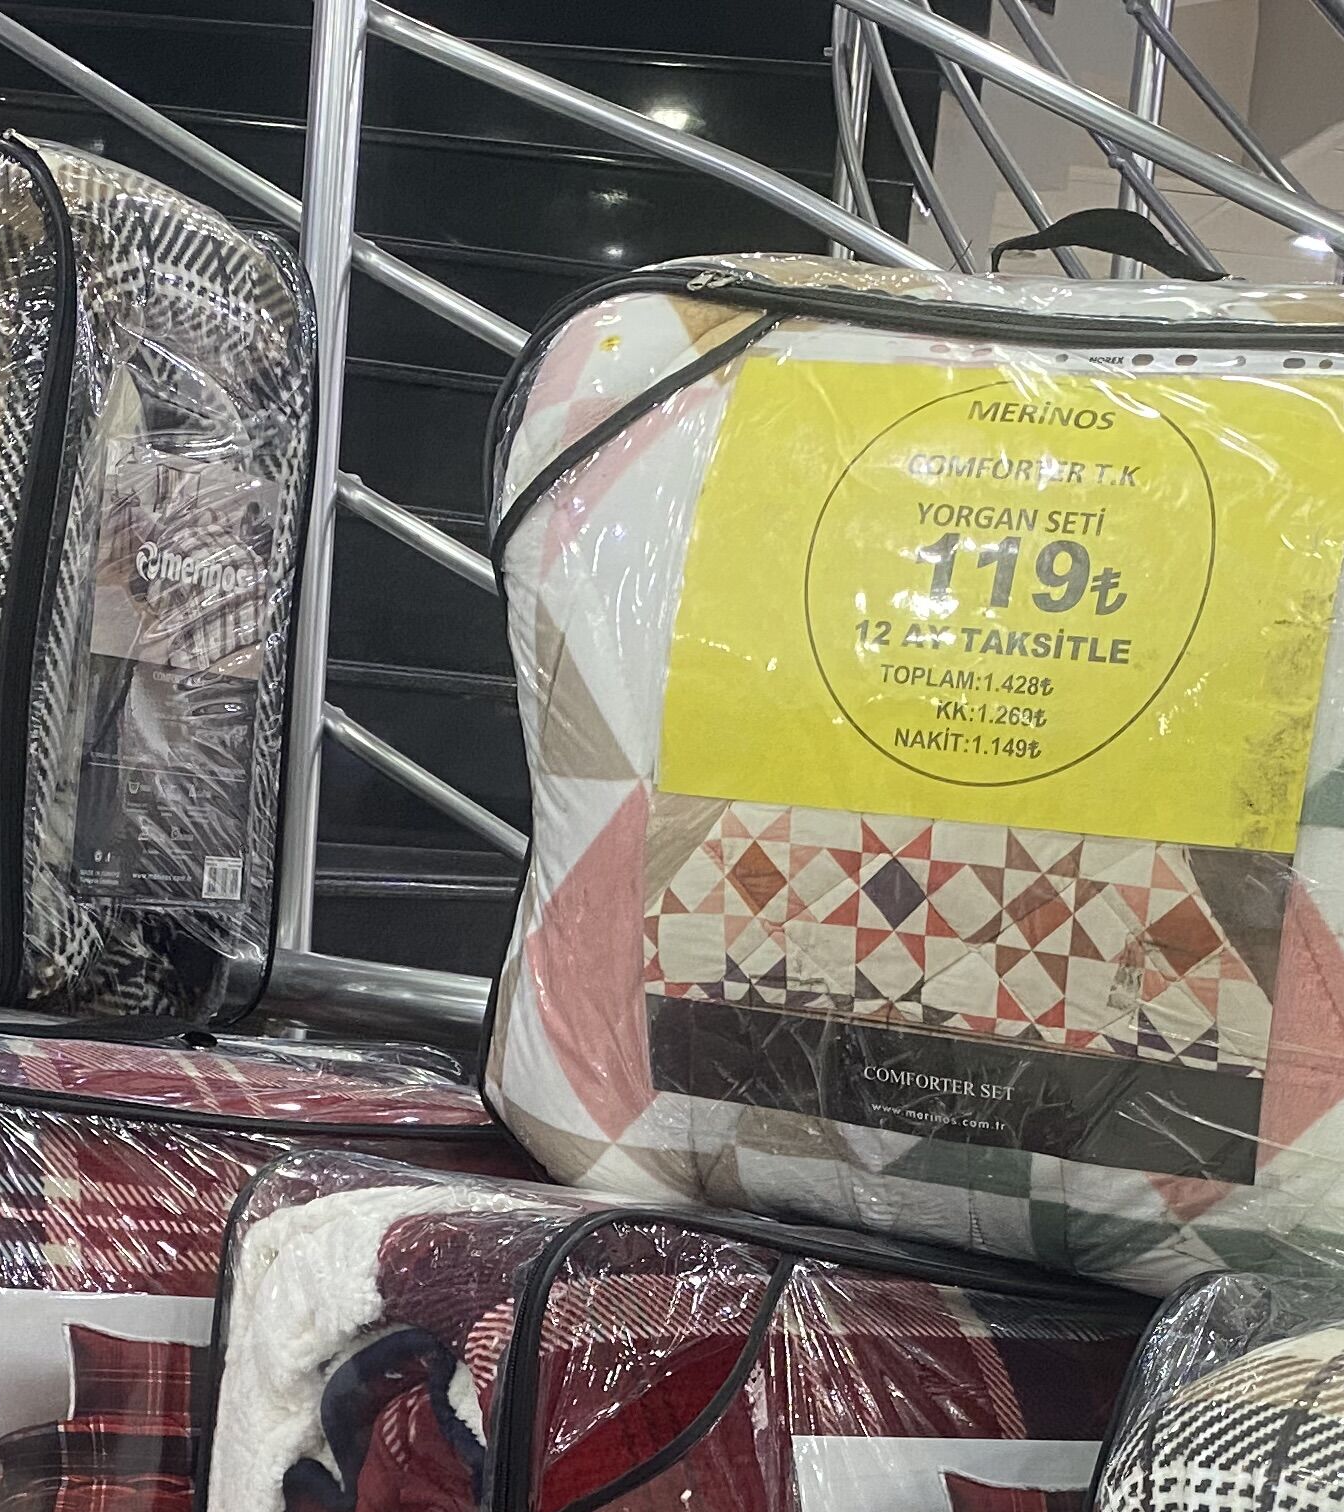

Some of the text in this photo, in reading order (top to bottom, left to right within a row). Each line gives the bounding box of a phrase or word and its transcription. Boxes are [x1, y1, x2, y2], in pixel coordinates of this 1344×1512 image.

[967, 400, 1116, 430] MERİNOS
[908, 453, 1142, 487] COMFORTER T.K
[917, 502, 1106, 536] YORGAN SETİ
[854, 619, 1133, 664] 12 AY TAKSİTLE
[863, 1065, 1015, 1101] COMFORTER SET
[871, 1102, 1006, 1131] www.merinos.com.tr
